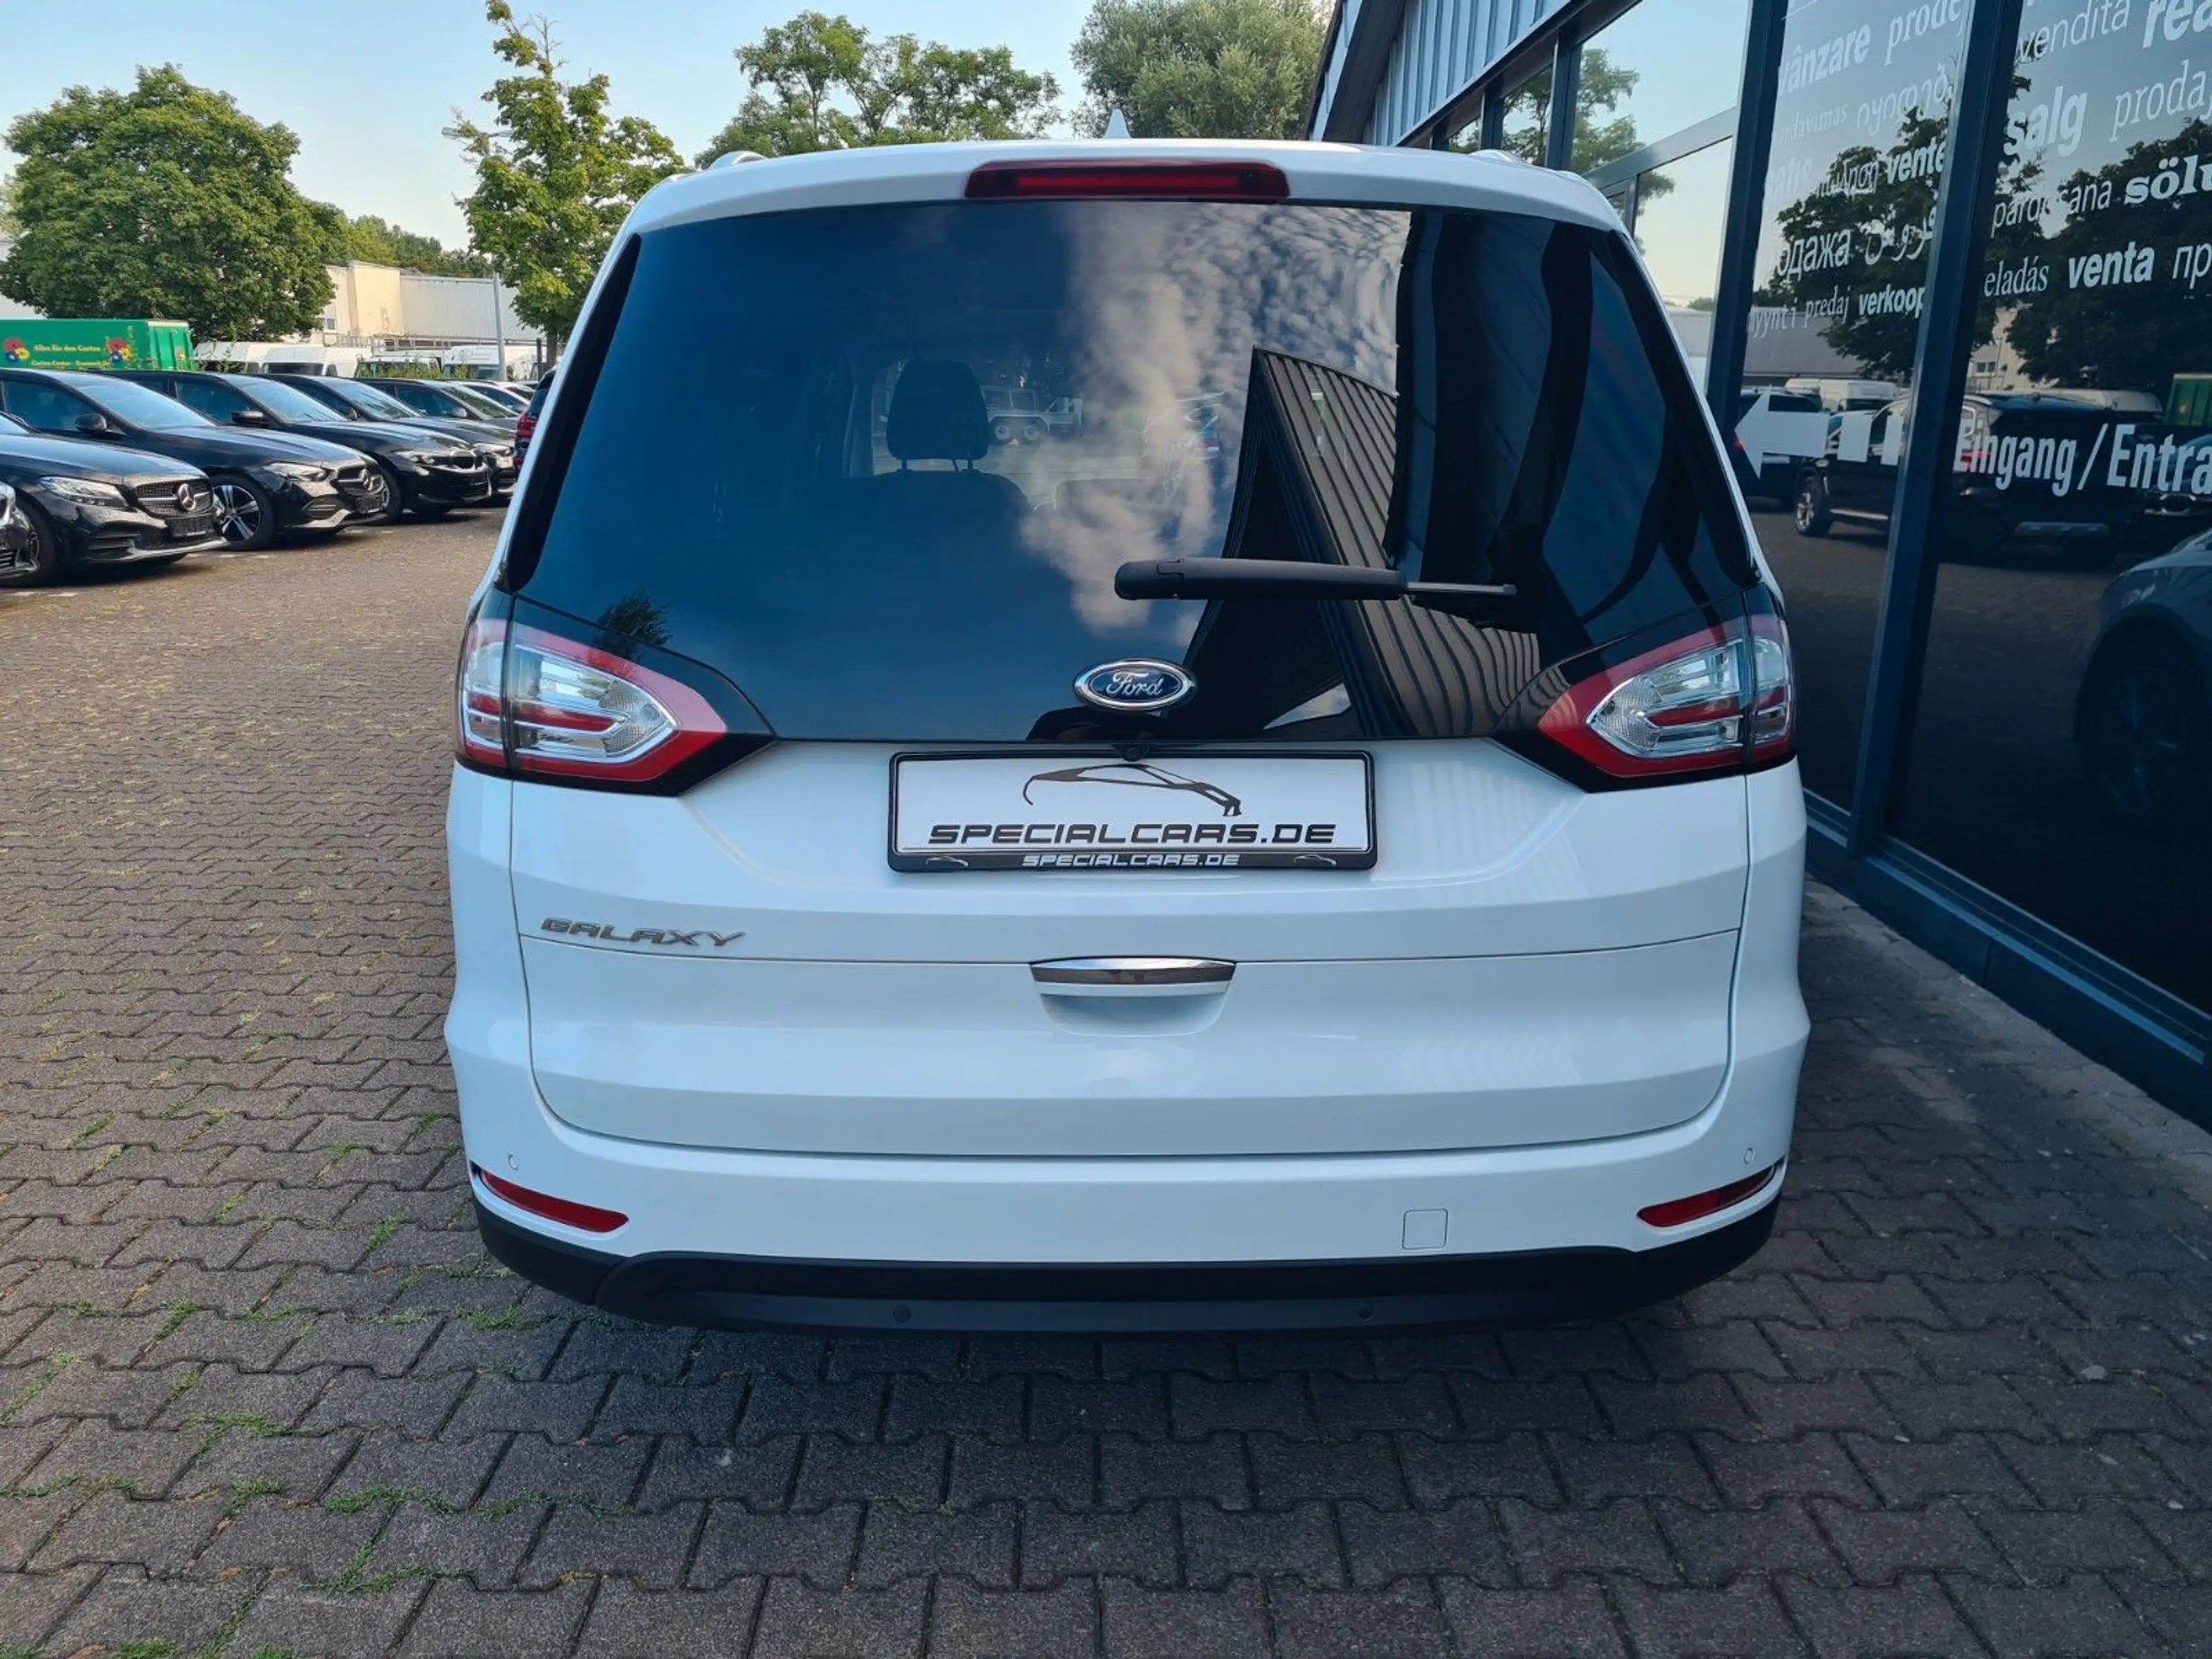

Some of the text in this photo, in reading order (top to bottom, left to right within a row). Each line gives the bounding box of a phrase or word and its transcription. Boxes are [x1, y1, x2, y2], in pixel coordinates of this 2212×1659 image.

[2003, 86, 2089, 157] salg
[1984, 241, 2155, 297] eladás venta
[1803, 285, 1851, 327] predaj
[1859, 284, 1926, 319] verkoop
[1105, 671, 1164, 699] Ford
[927, 823, 1337, 845] SPECIALCARS.DE
[1021, 853, 1241, 867] SPECIALCARS.DE
[540, 917, 747, 947] GALAXY
